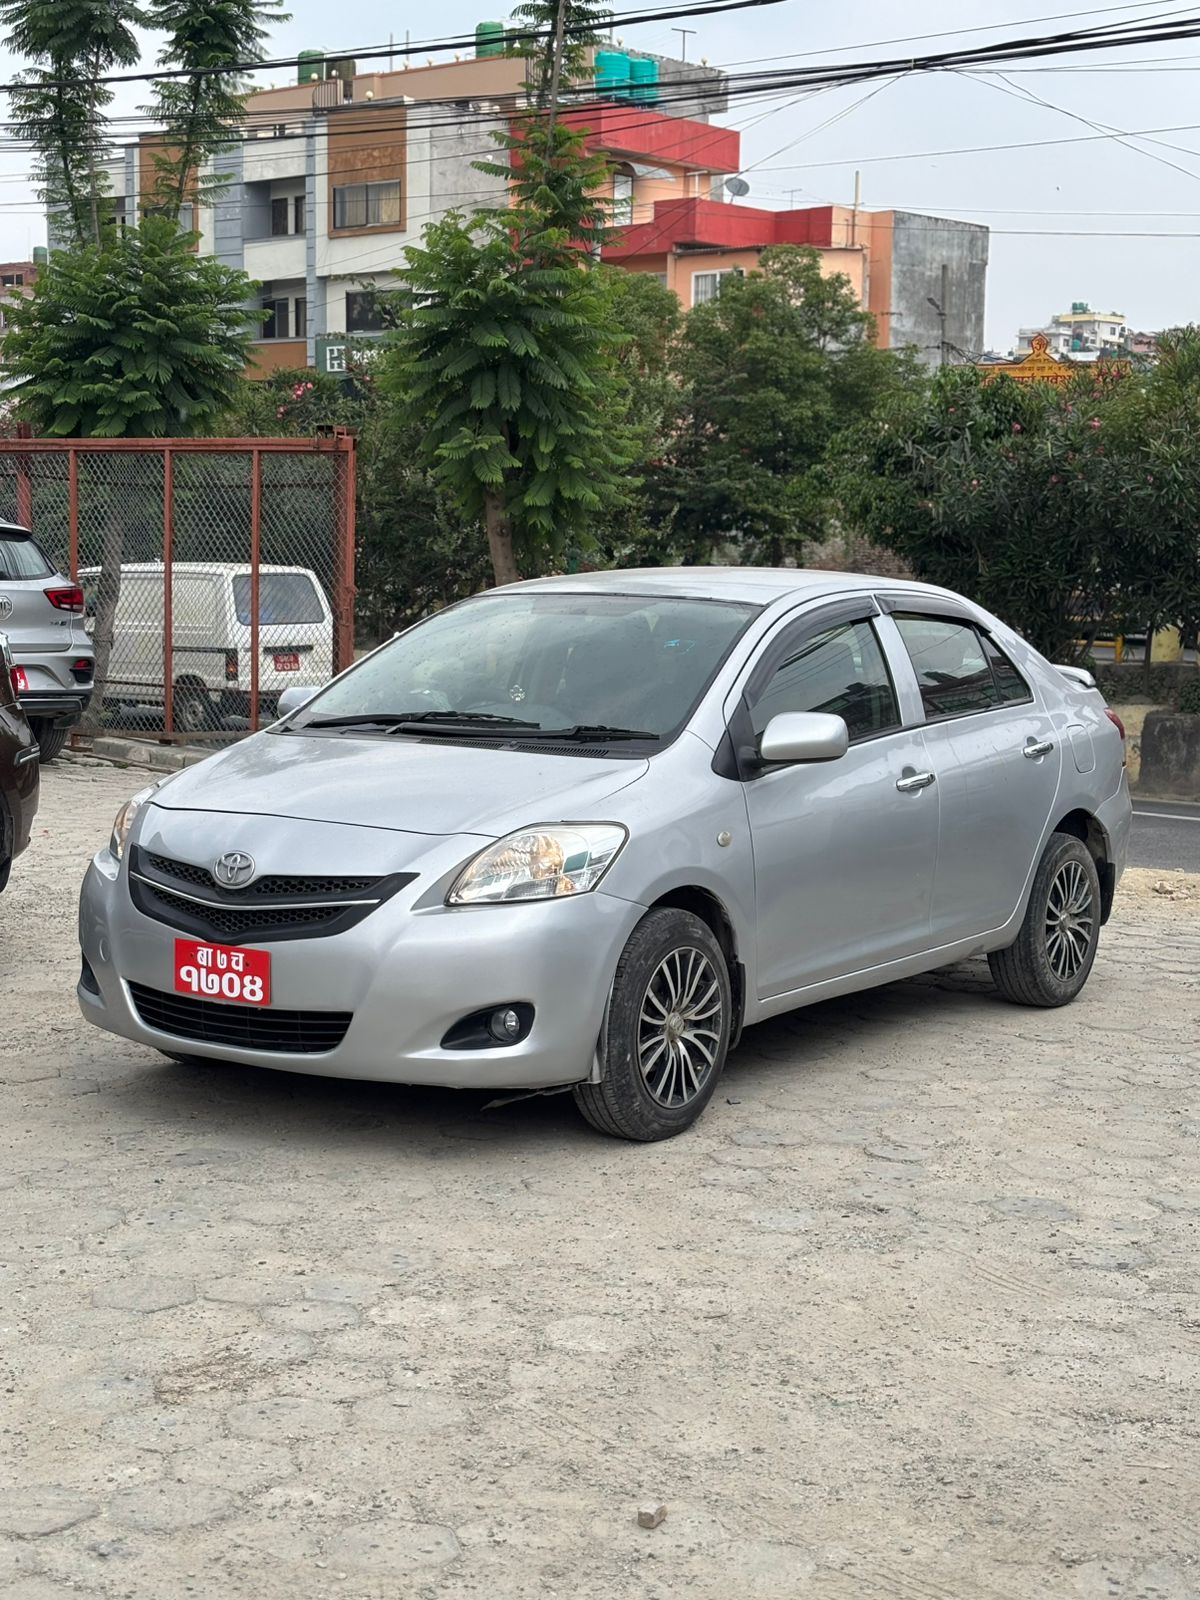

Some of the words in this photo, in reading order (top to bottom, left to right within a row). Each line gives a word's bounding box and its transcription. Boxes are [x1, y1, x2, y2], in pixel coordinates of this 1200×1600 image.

[217, 949, 227, 969] ७
[231, 952, 244, 972] च
[180, 965, 263, 1001] १७०४
